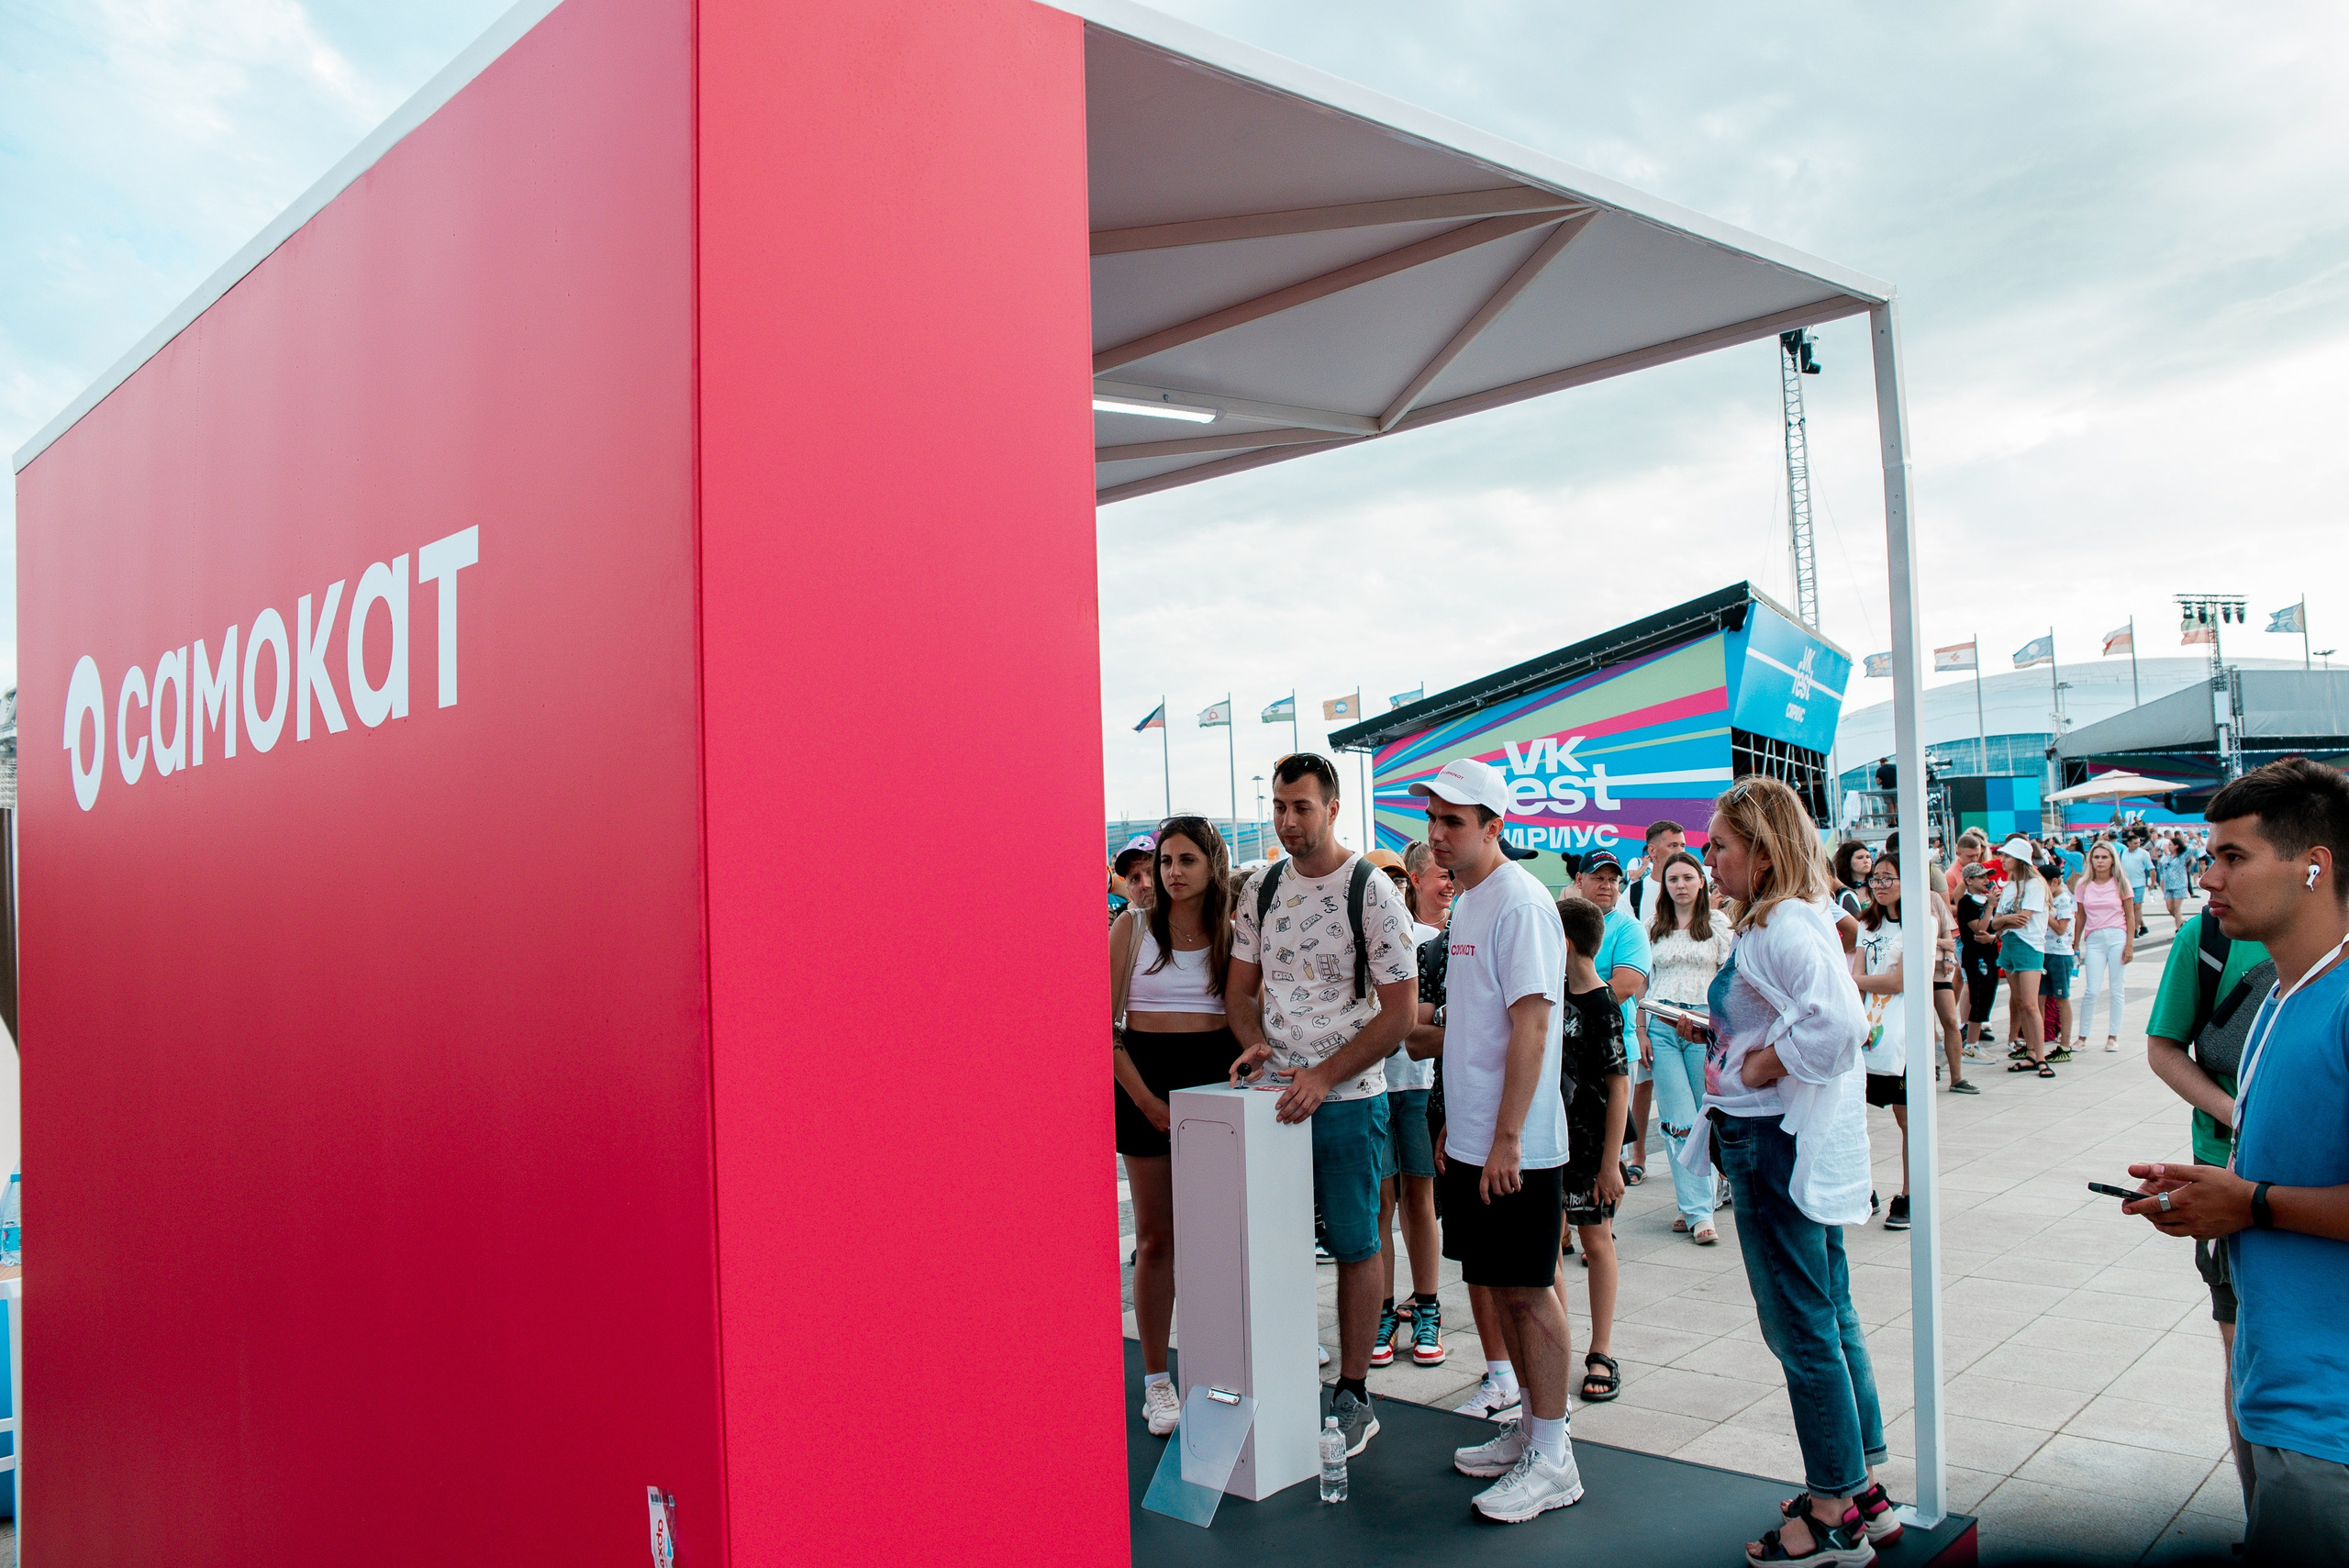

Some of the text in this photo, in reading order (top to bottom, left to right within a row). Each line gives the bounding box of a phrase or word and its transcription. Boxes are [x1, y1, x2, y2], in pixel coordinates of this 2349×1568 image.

[117, 524, 479, 785] самокат
[1802, 645, 1816, 673] VK
[1791, 661, 1814, 701] fest
[1503, 736, 1587, 775] VK
[1499, 763, 1621, 816] est
[1504, 824, 1620, 849] ИРИУС
